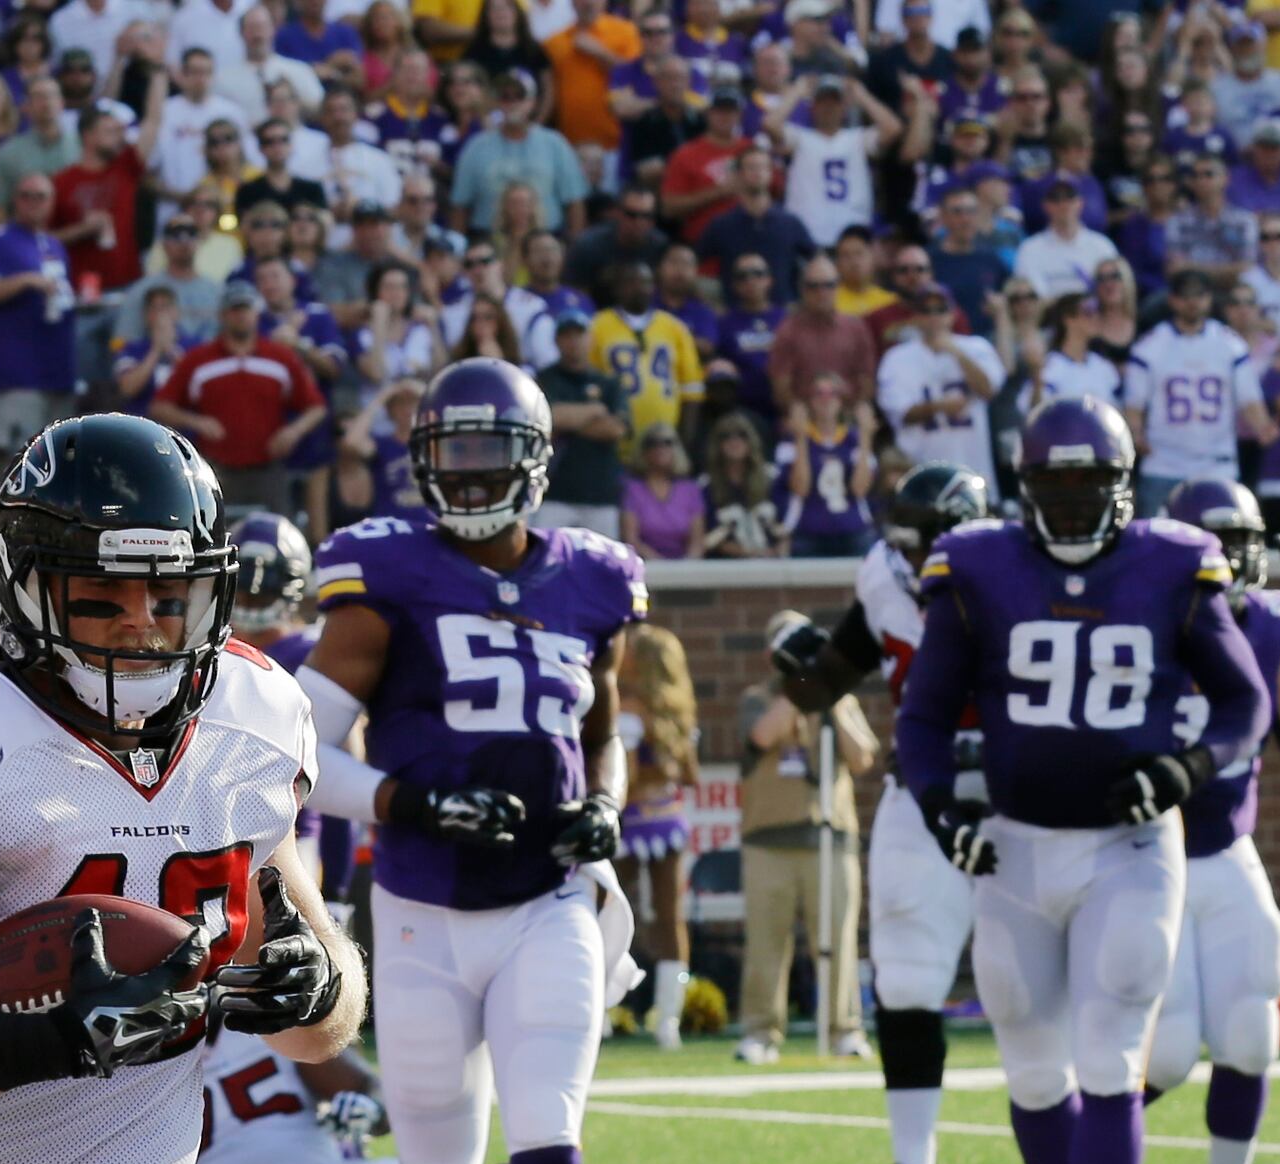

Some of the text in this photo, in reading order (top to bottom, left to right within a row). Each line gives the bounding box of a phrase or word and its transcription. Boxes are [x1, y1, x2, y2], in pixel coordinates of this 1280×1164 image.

[824, 159, 849, 202] 5
[610, 345, 673, 397] 84
[1166, 376, 1223, 425] 69
[122, 538, 169, 546] FALCONS
[437, 614, 596, 738] 55
[1007, 620, 1153, 730] 98
[111, 825, 190, 838] FALCONS
